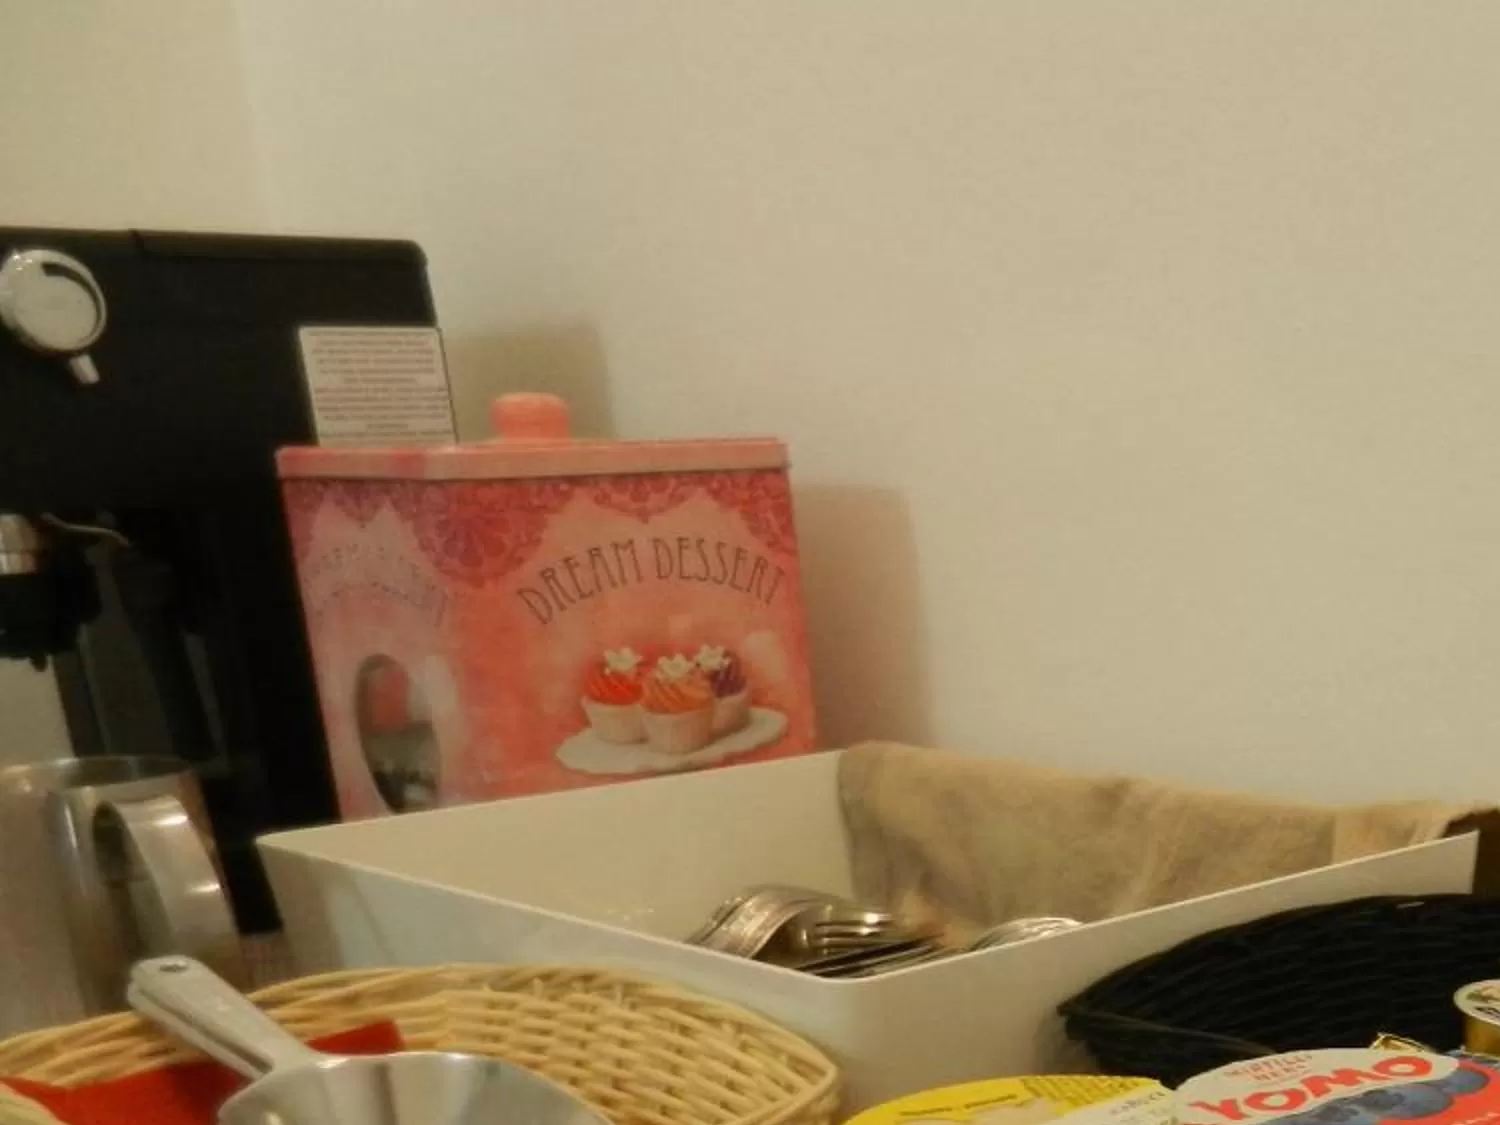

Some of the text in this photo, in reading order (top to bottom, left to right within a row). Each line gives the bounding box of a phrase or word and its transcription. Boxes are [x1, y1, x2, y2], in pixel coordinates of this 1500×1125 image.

[516, 537, 645, 625] DREAM
[650, 536, 785, 607] DESSERT
[1187, 1055, 1434, 1121] YOMO
